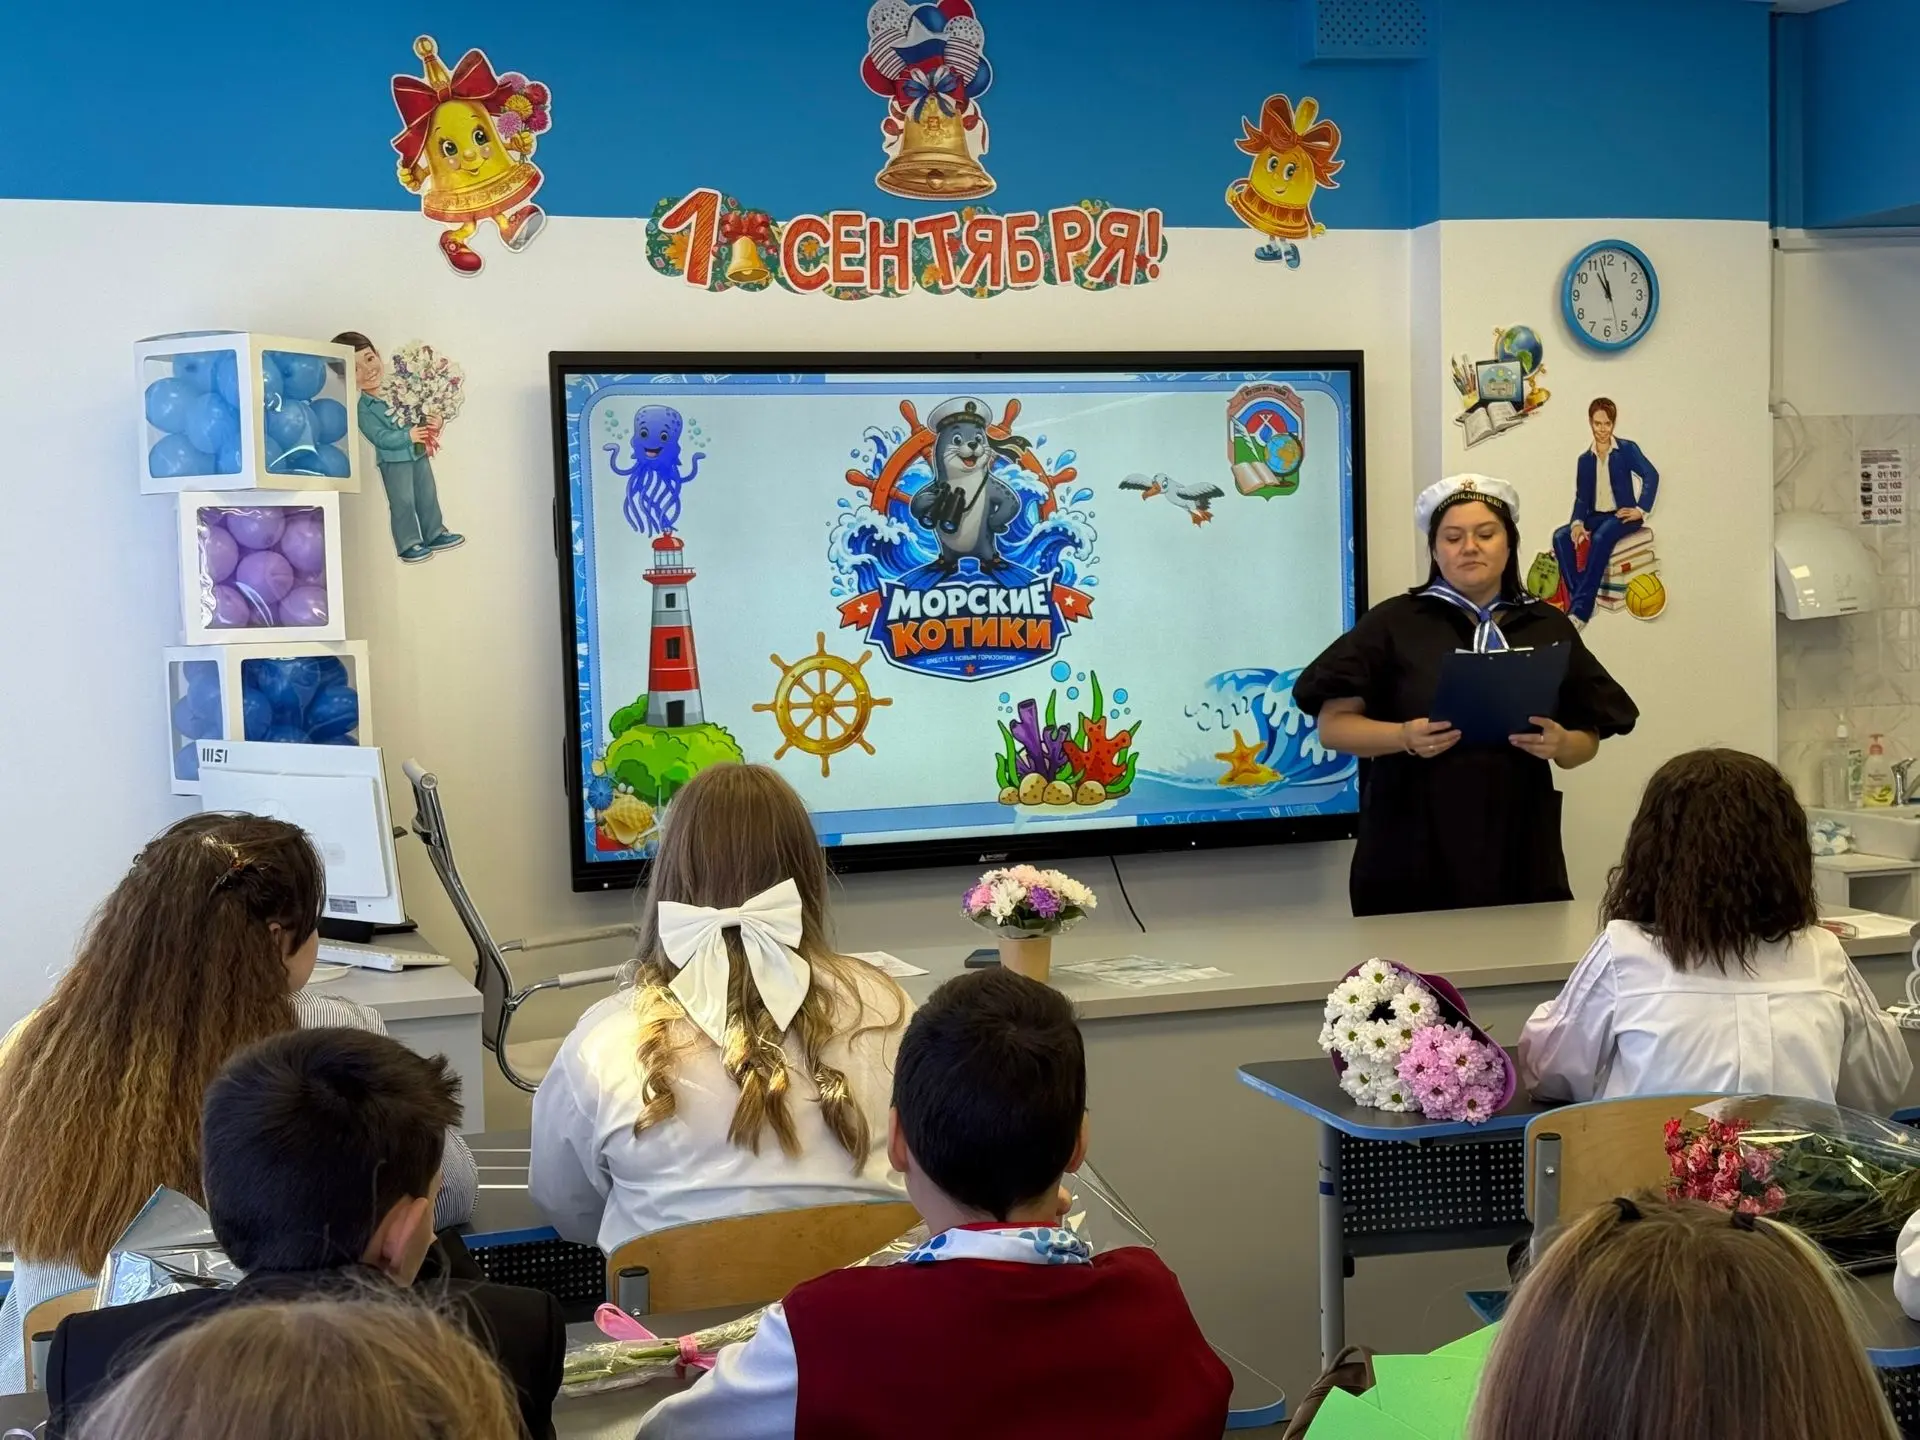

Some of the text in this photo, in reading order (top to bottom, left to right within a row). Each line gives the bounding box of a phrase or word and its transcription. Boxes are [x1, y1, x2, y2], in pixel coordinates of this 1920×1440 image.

[660, 189, 1163, 293] 1 СЕНТЯБРЯ!
[1588, 259, 1597, 270] 11
[1602, 254, 1615, 266] 12
[1623, 261, 1627, 272] 1
[1577, 272, 1588, 284] 10
[1631, 272, 1638, 284] 2
[1573, 290, 1580, 301] 9
[1636, 289, 1643, 301] 3
[1577, 308, 1585, 320] 8
[1631, 308, 1638, 319] 4
[1589, 321, 1596, 332] 7
[1603, 326, 1611, 337] 6
[1620, 320, 1628, 332] 5
[887, 582, 1051, 621] МОРСКИЕ
[888, 616, 1052, 657] КОТИКИ
